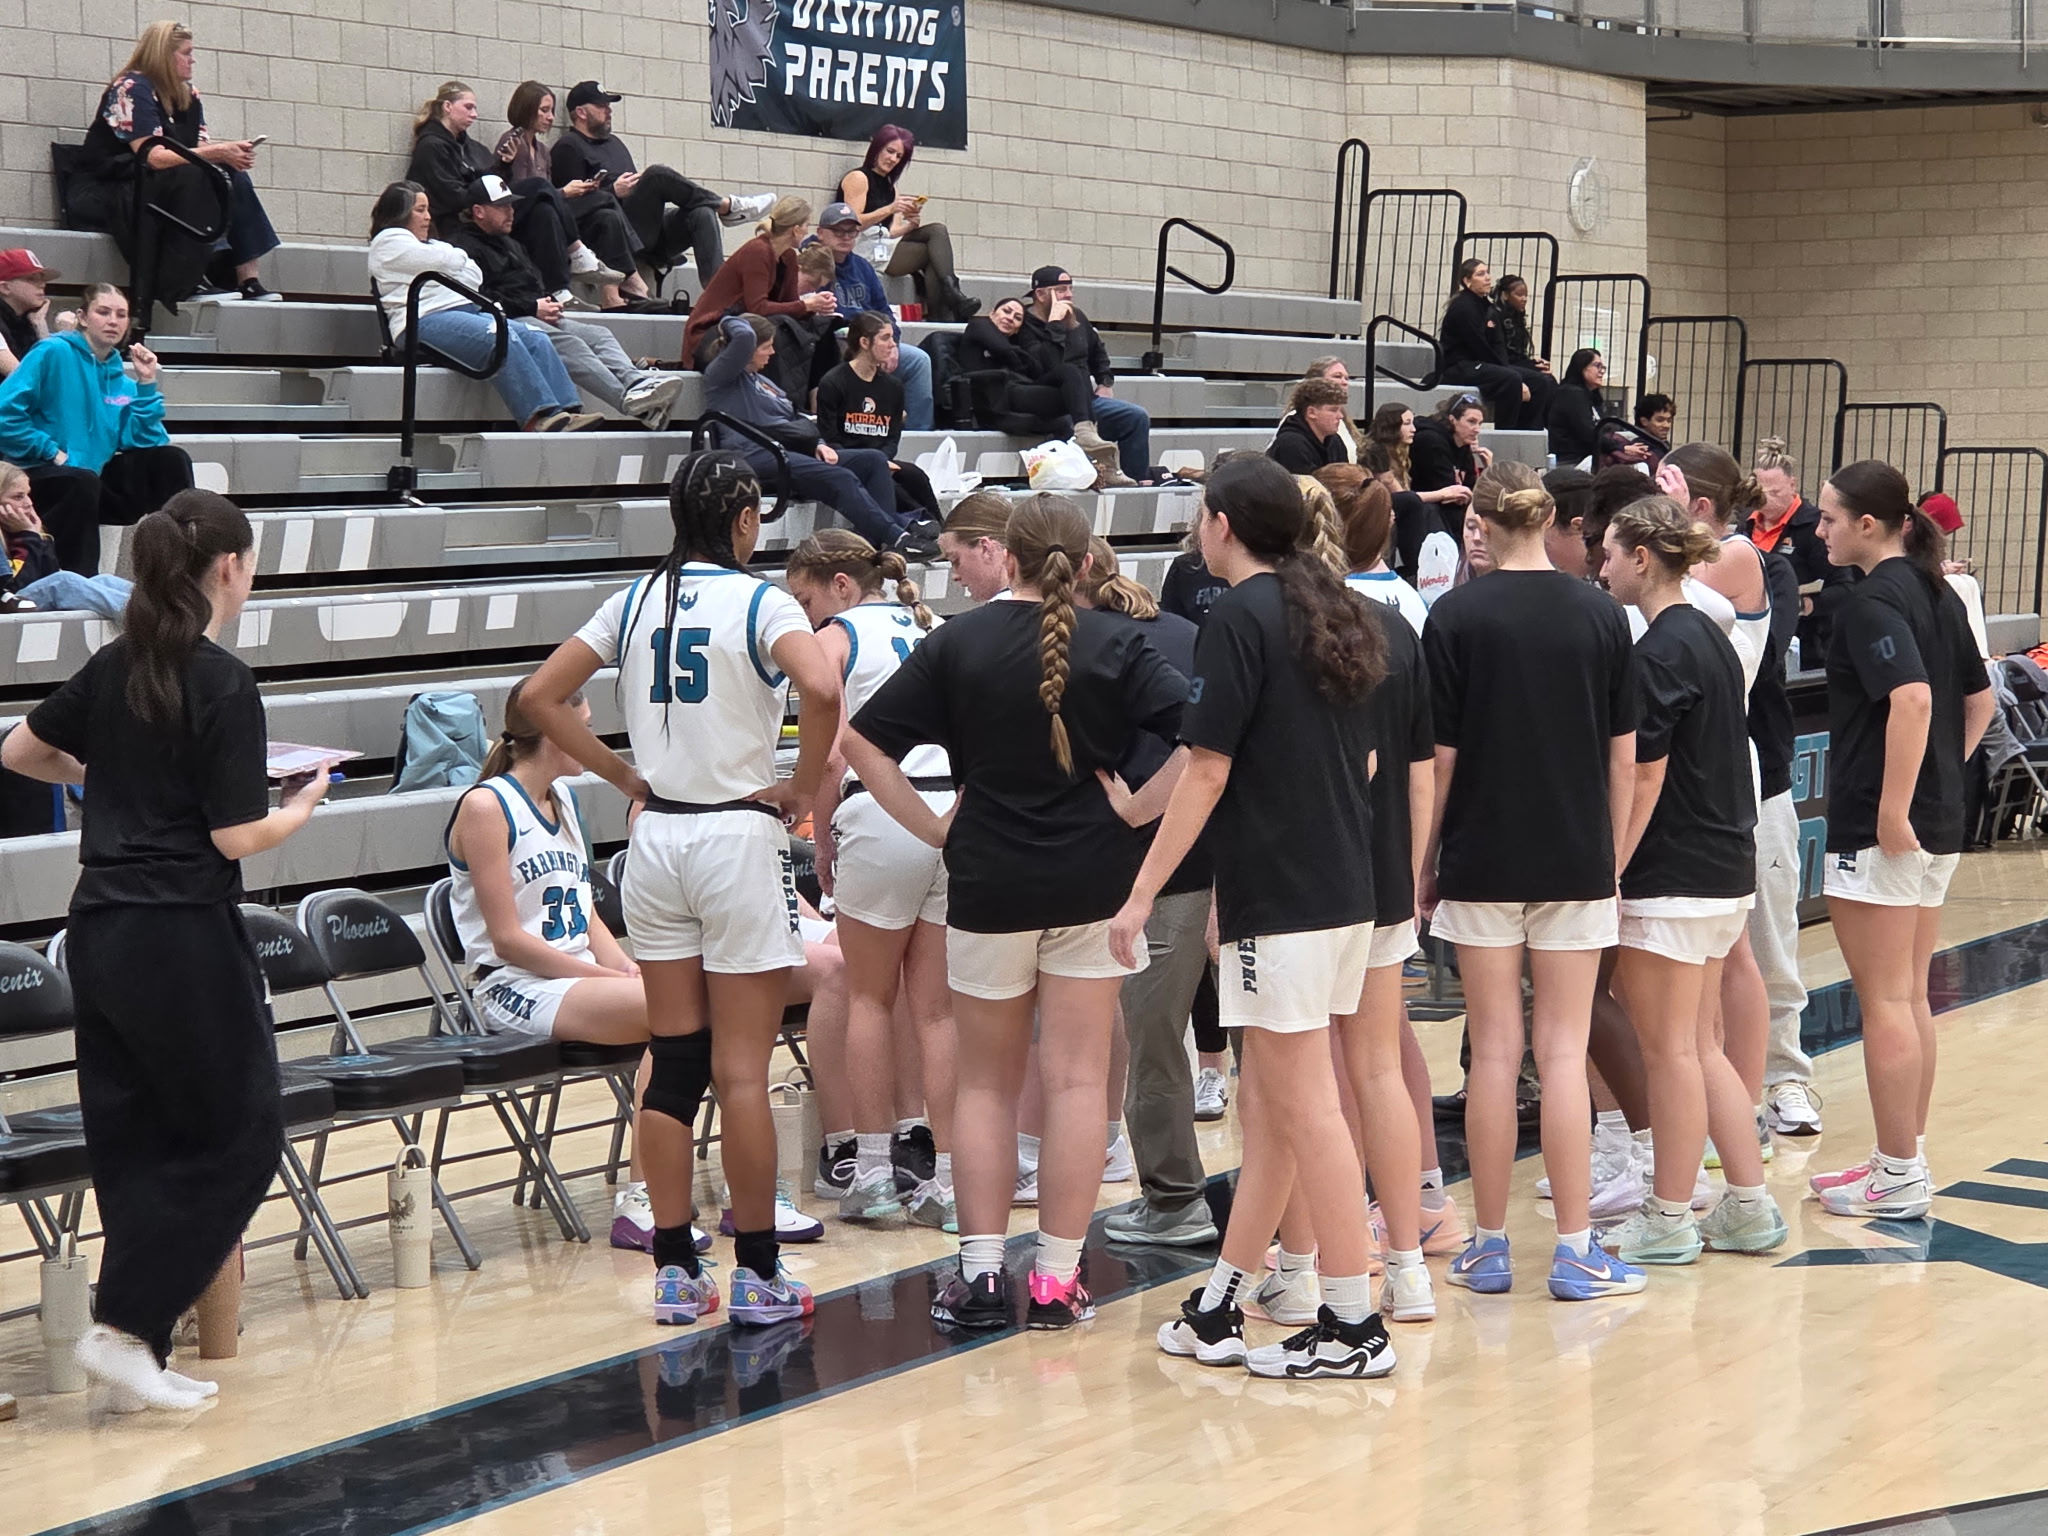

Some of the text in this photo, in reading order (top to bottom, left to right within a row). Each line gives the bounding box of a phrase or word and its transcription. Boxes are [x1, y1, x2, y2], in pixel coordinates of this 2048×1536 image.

[784, 42, 949, 112] PARENTS
[845, 412, 891, 426] MURRAY
[650, 627, 711, 703] 15
[327, 914, 390, 943] Phoenix
[541, 885, 588, 941] 33
